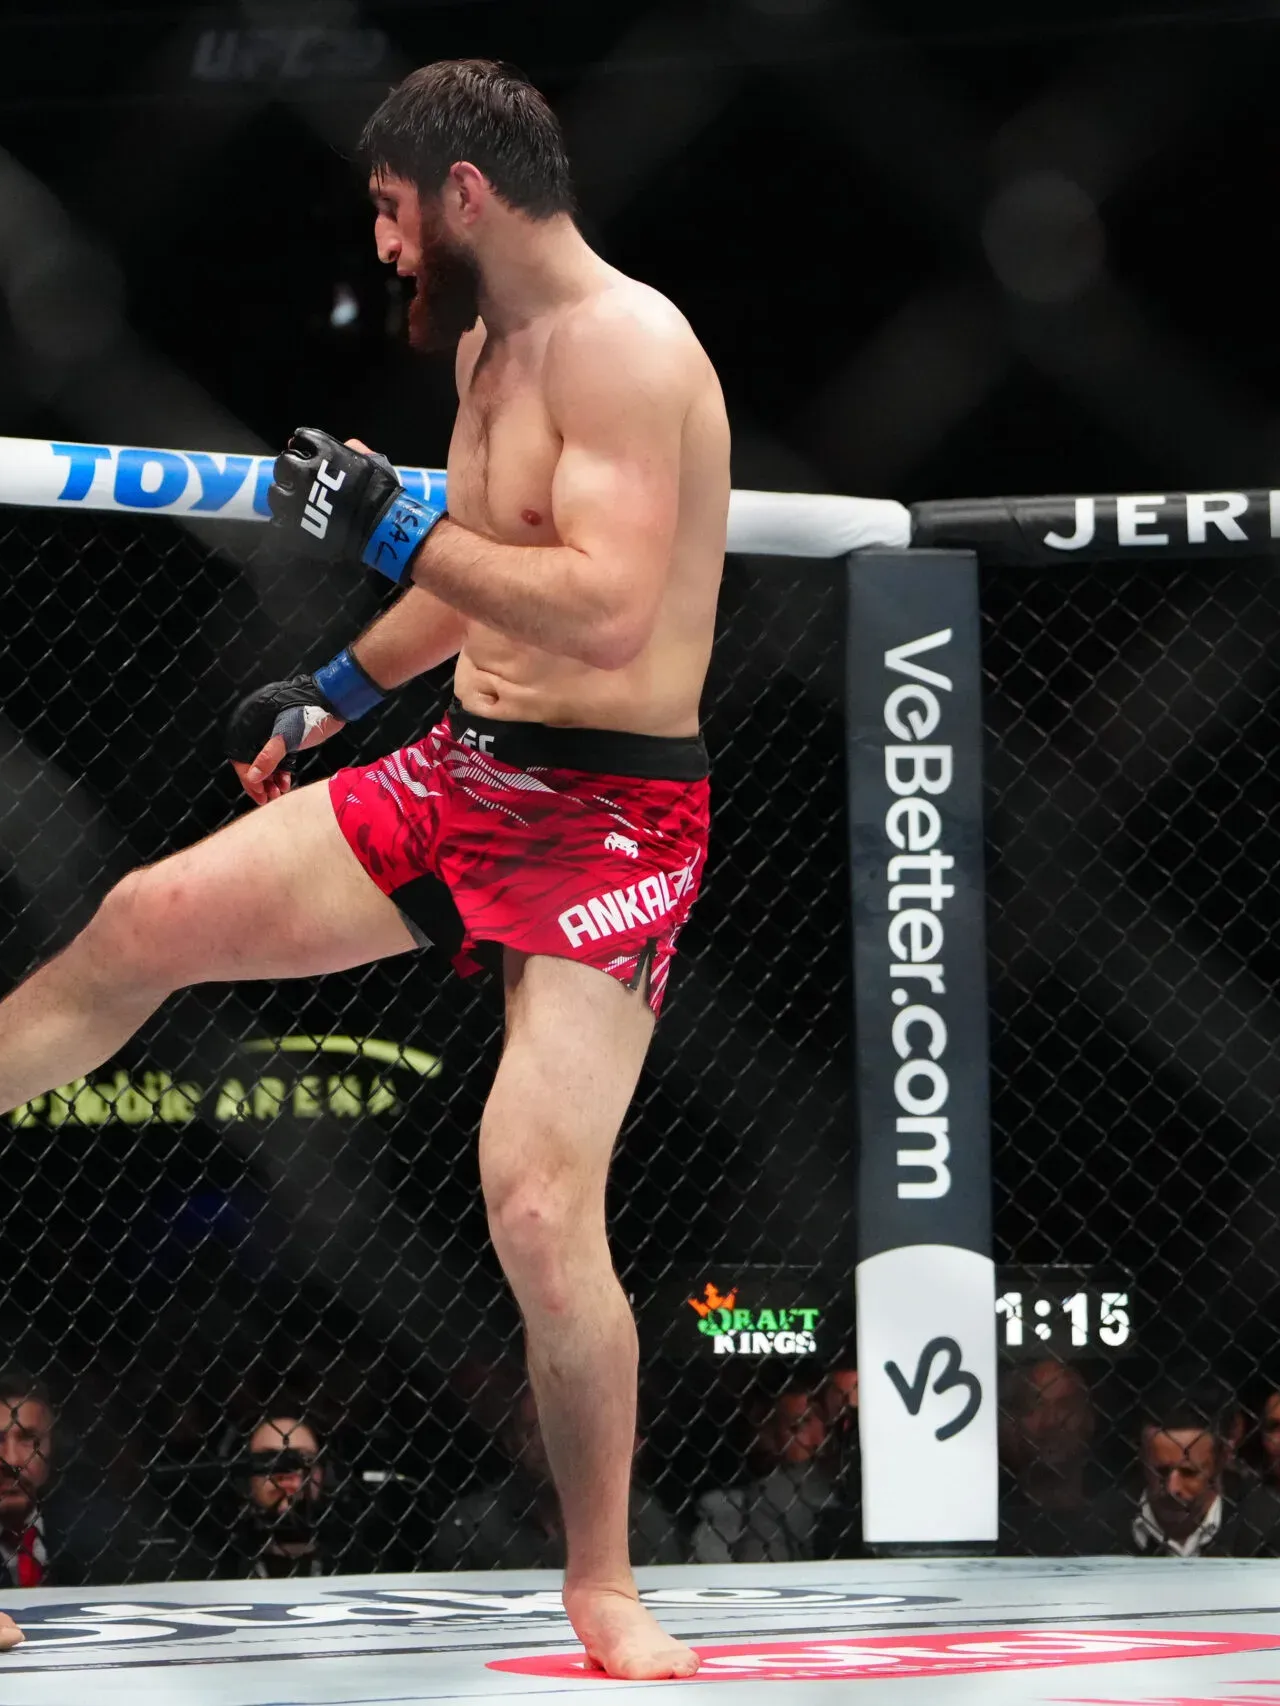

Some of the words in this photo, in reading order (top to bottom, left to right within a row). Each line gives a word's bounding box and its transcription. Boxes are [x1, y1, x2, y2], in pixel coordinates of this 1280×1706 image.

[50, 443, 276, 517] TOY
[300, 459, 346, 540] UFC
[883, 627, 956, 1200] VeBetter.com
[215, 1074, 400, 1120] ARENA
[697, 1307, 820, 1336] DRAFT
[713, 1329, 817, 1354] KINGS
[573, 1632, 1228, 1674] otal
